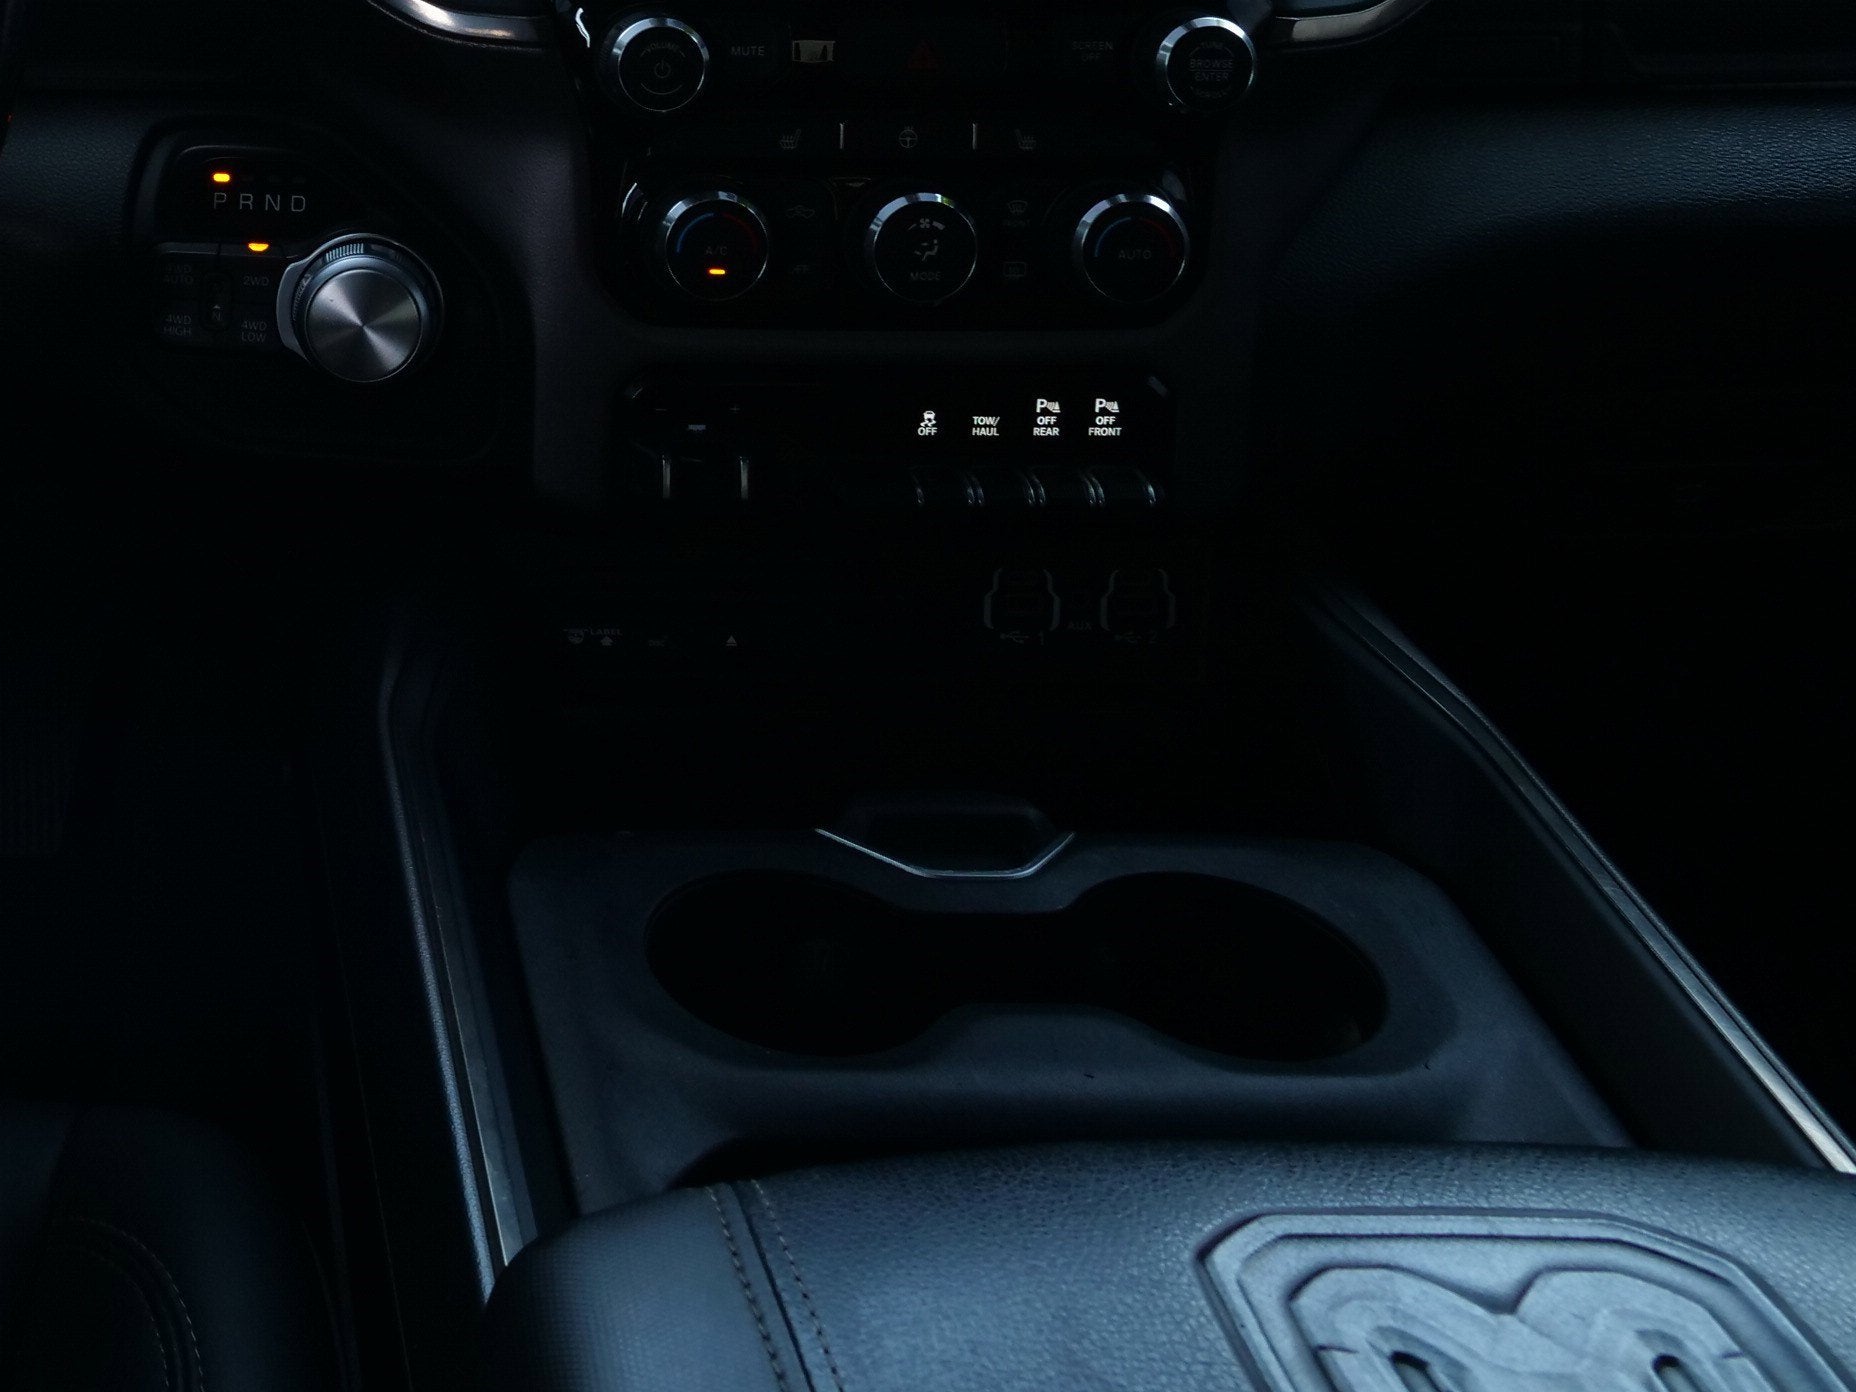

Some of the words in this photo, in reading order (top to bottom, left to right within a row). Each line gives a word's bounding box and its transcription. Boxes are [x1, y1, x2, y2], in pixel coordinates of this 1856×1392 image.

[730, 45, 766, 57] MUTE
[1189, 59, 1234, 69] BROWSE
[1194, 71, 1230, 82] ENTER
[213, 192, 228, 210] P
[238, 193, 254, 210] R
[264, 194, 281, 212] N
[290, 195, 307, 213] D
[704, 245, 728, 256] A/C
[1117, 248, 1152, 260] AUTO
[242, 275, 270, 287] 2WD
[909, 271, 942, 281] MODE
[165, 314, 192, 325] 4WD
[163, 325, 192, 336] HIGH
[241, 320, 268, 332] 4WD
[240, 331, 267, 343] LOW
[971, 415, 1001, 426] TOW/
[1036, 416, 1057, 426] OFF
[1094, 416, 1116, 426] OFF
[917, 427, 938, 437] OFF
[971, 427, 1000, 437] HAUL
[1033, 427, 1060, 437] REAR
[1088, 427, 1122, 437] FRONT
